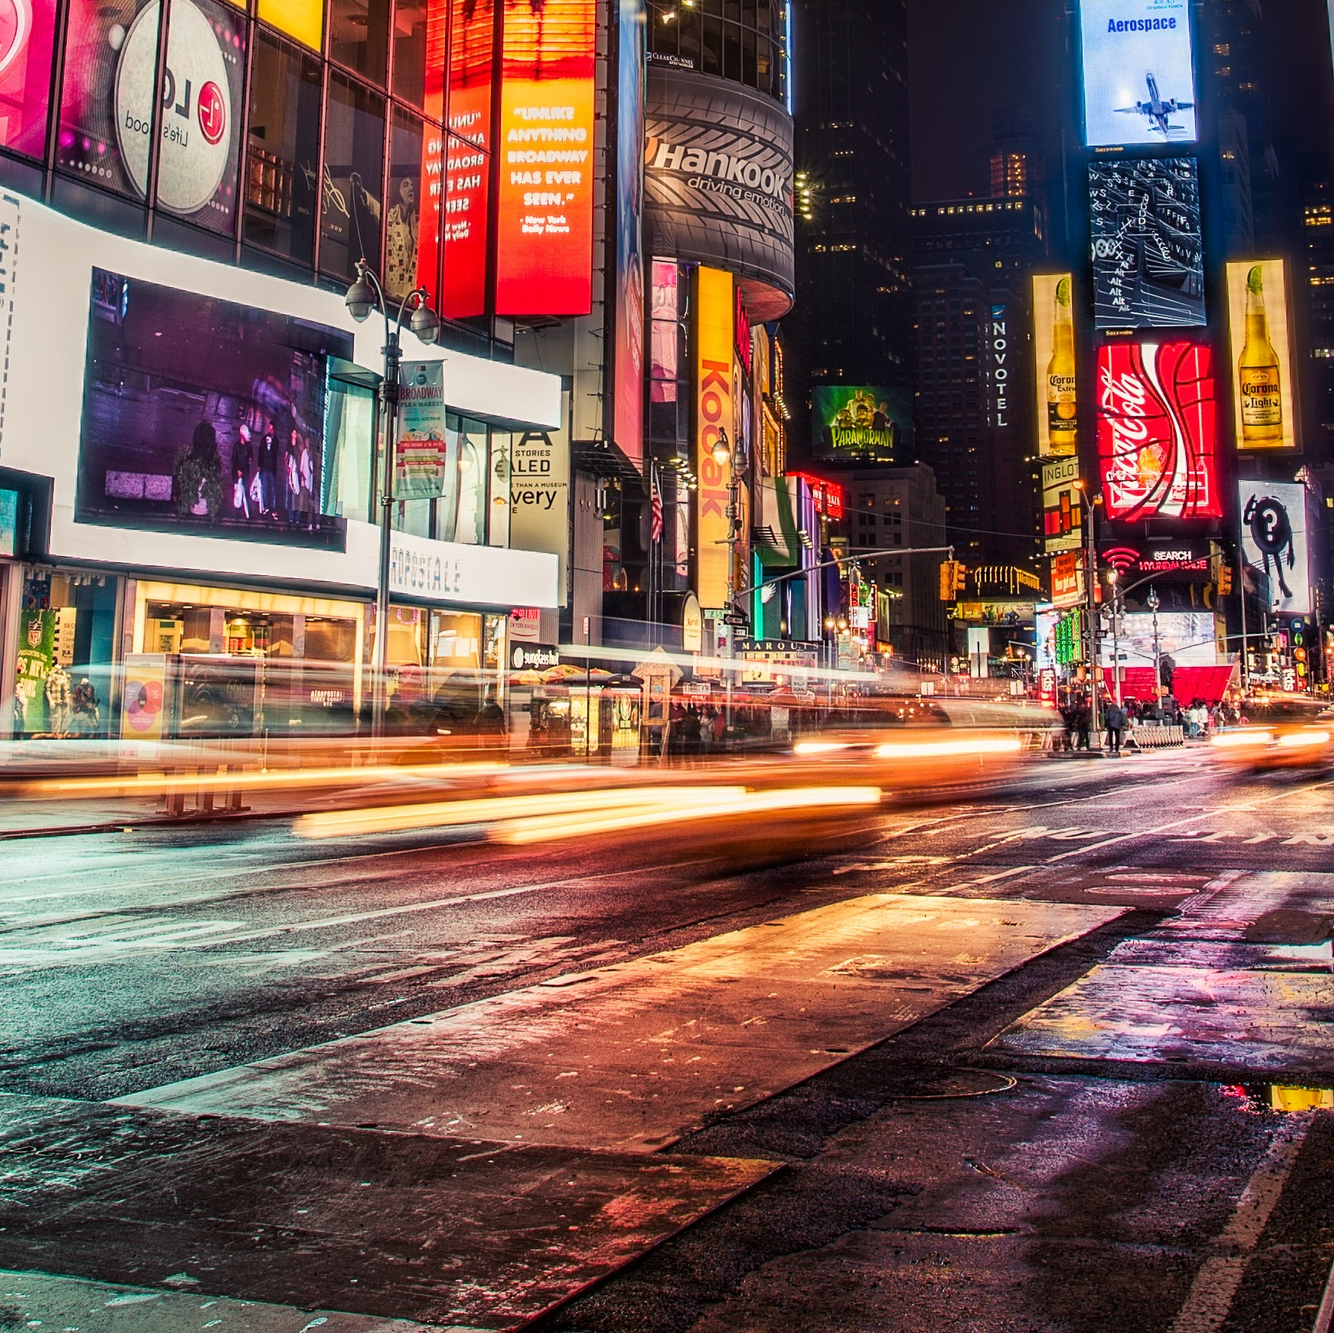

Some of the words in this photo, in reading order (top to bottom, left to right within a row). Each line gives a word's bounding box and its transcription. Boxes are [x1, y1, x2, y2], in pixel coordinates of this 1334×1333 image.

[1108, 17, 1176, 33] Aerospace
[507, 128, 587, 143] ANYTHING
[507, 150, 588, 164] BROADWAY
[510, 171, 542, 185] HAS
[545, 171, 581, 185] EVER
[687, 175, 743, 200] driving
[743, 189, 786, 217] emotion
[522, 225, 544, 236] Daily
[993, 322, 1008, 427] NOVOTEL
[400, 386, 443, 401] BROADWAY
[1242, 382, 1278, 397] Corona
[1250, 397, 1273, 408] Light
[832, 426, 894, 451] PARANORMAN
[1100, 366, 1150, 500] Coca-Cola
[515, 449, 551, 457] STORIES
[1044, 463, 1079, 482] INGLOT
[1154, 551, 1192, 560] SEARCH
[741, 642, 820, 651] MARQUIS
[524, 649, 549, 668] sunglass
[549, 650, 559, 665] hut
